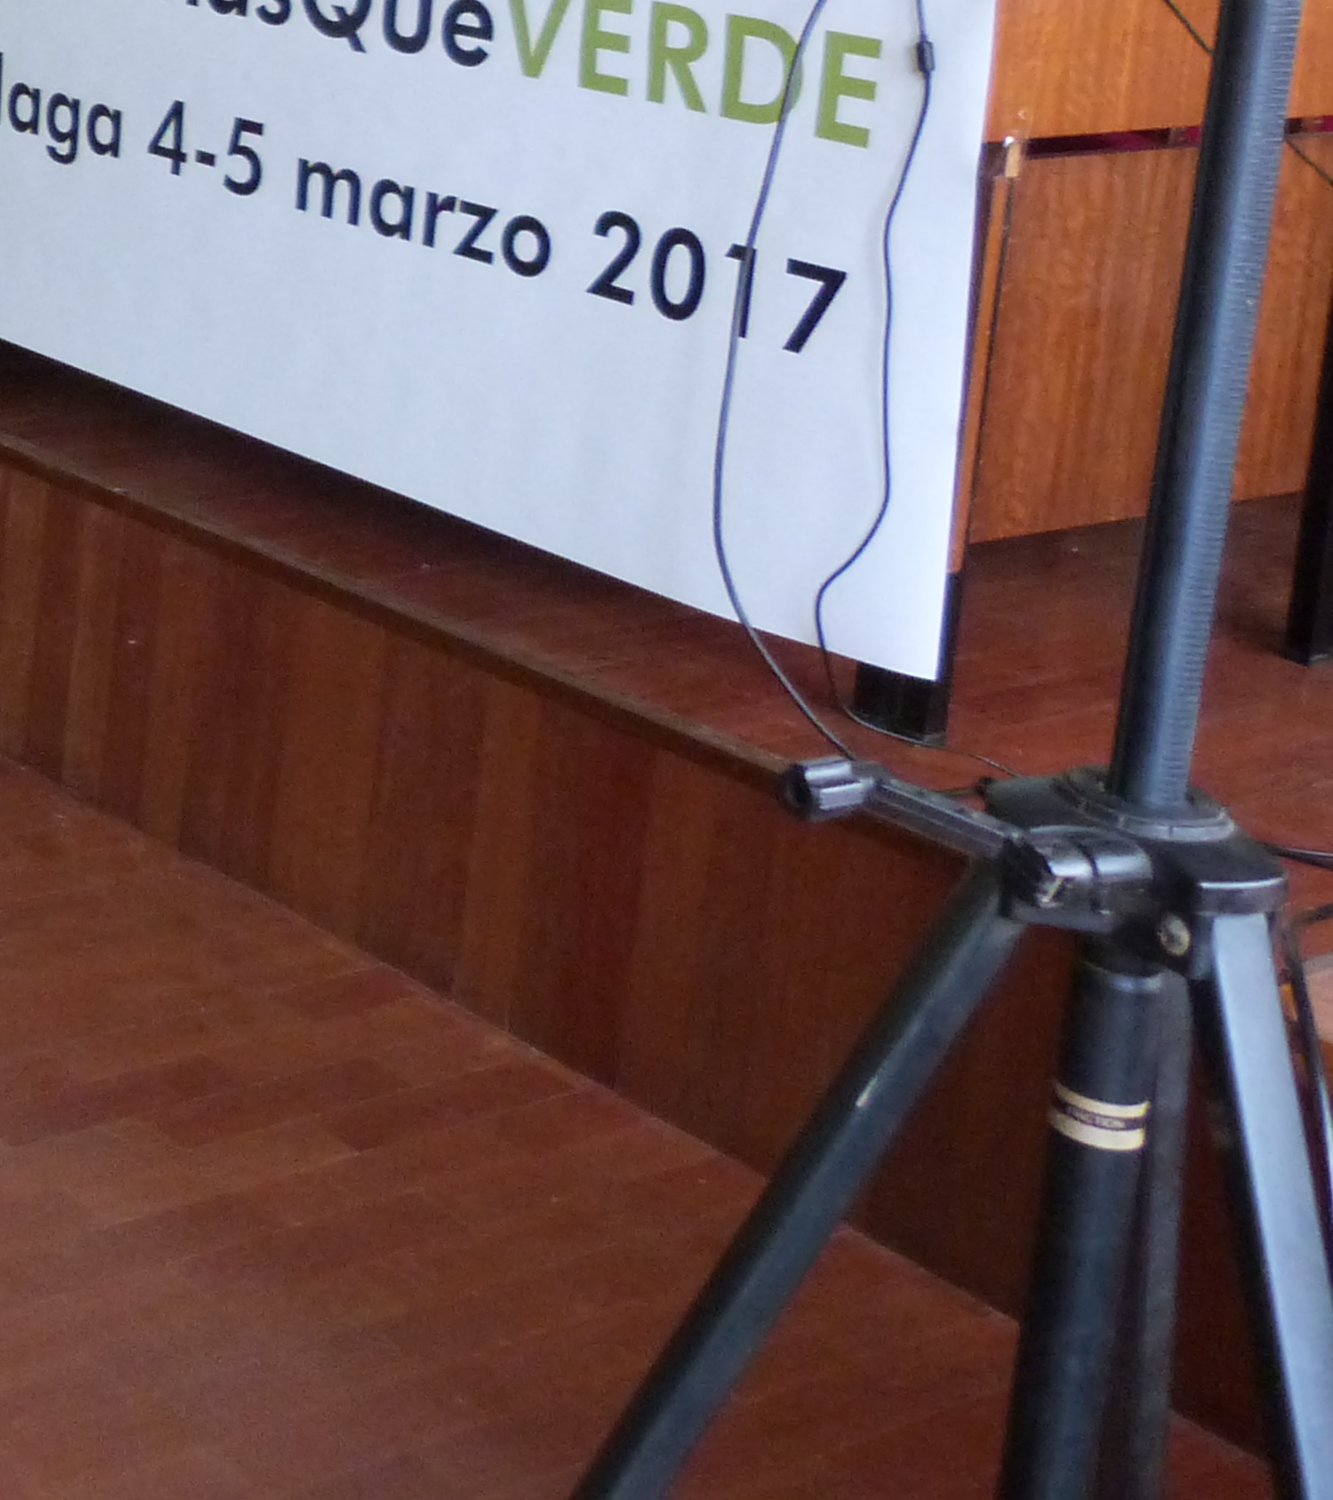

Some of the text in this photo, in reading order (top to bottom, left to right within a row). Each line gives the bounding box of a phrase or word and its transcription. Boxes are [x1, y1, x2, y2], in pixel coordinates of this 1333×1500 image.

[147, 100, 264, 195] 4-5
[295, 157, 552, 277] marzo
[587, 210, 848, 354] 2017
